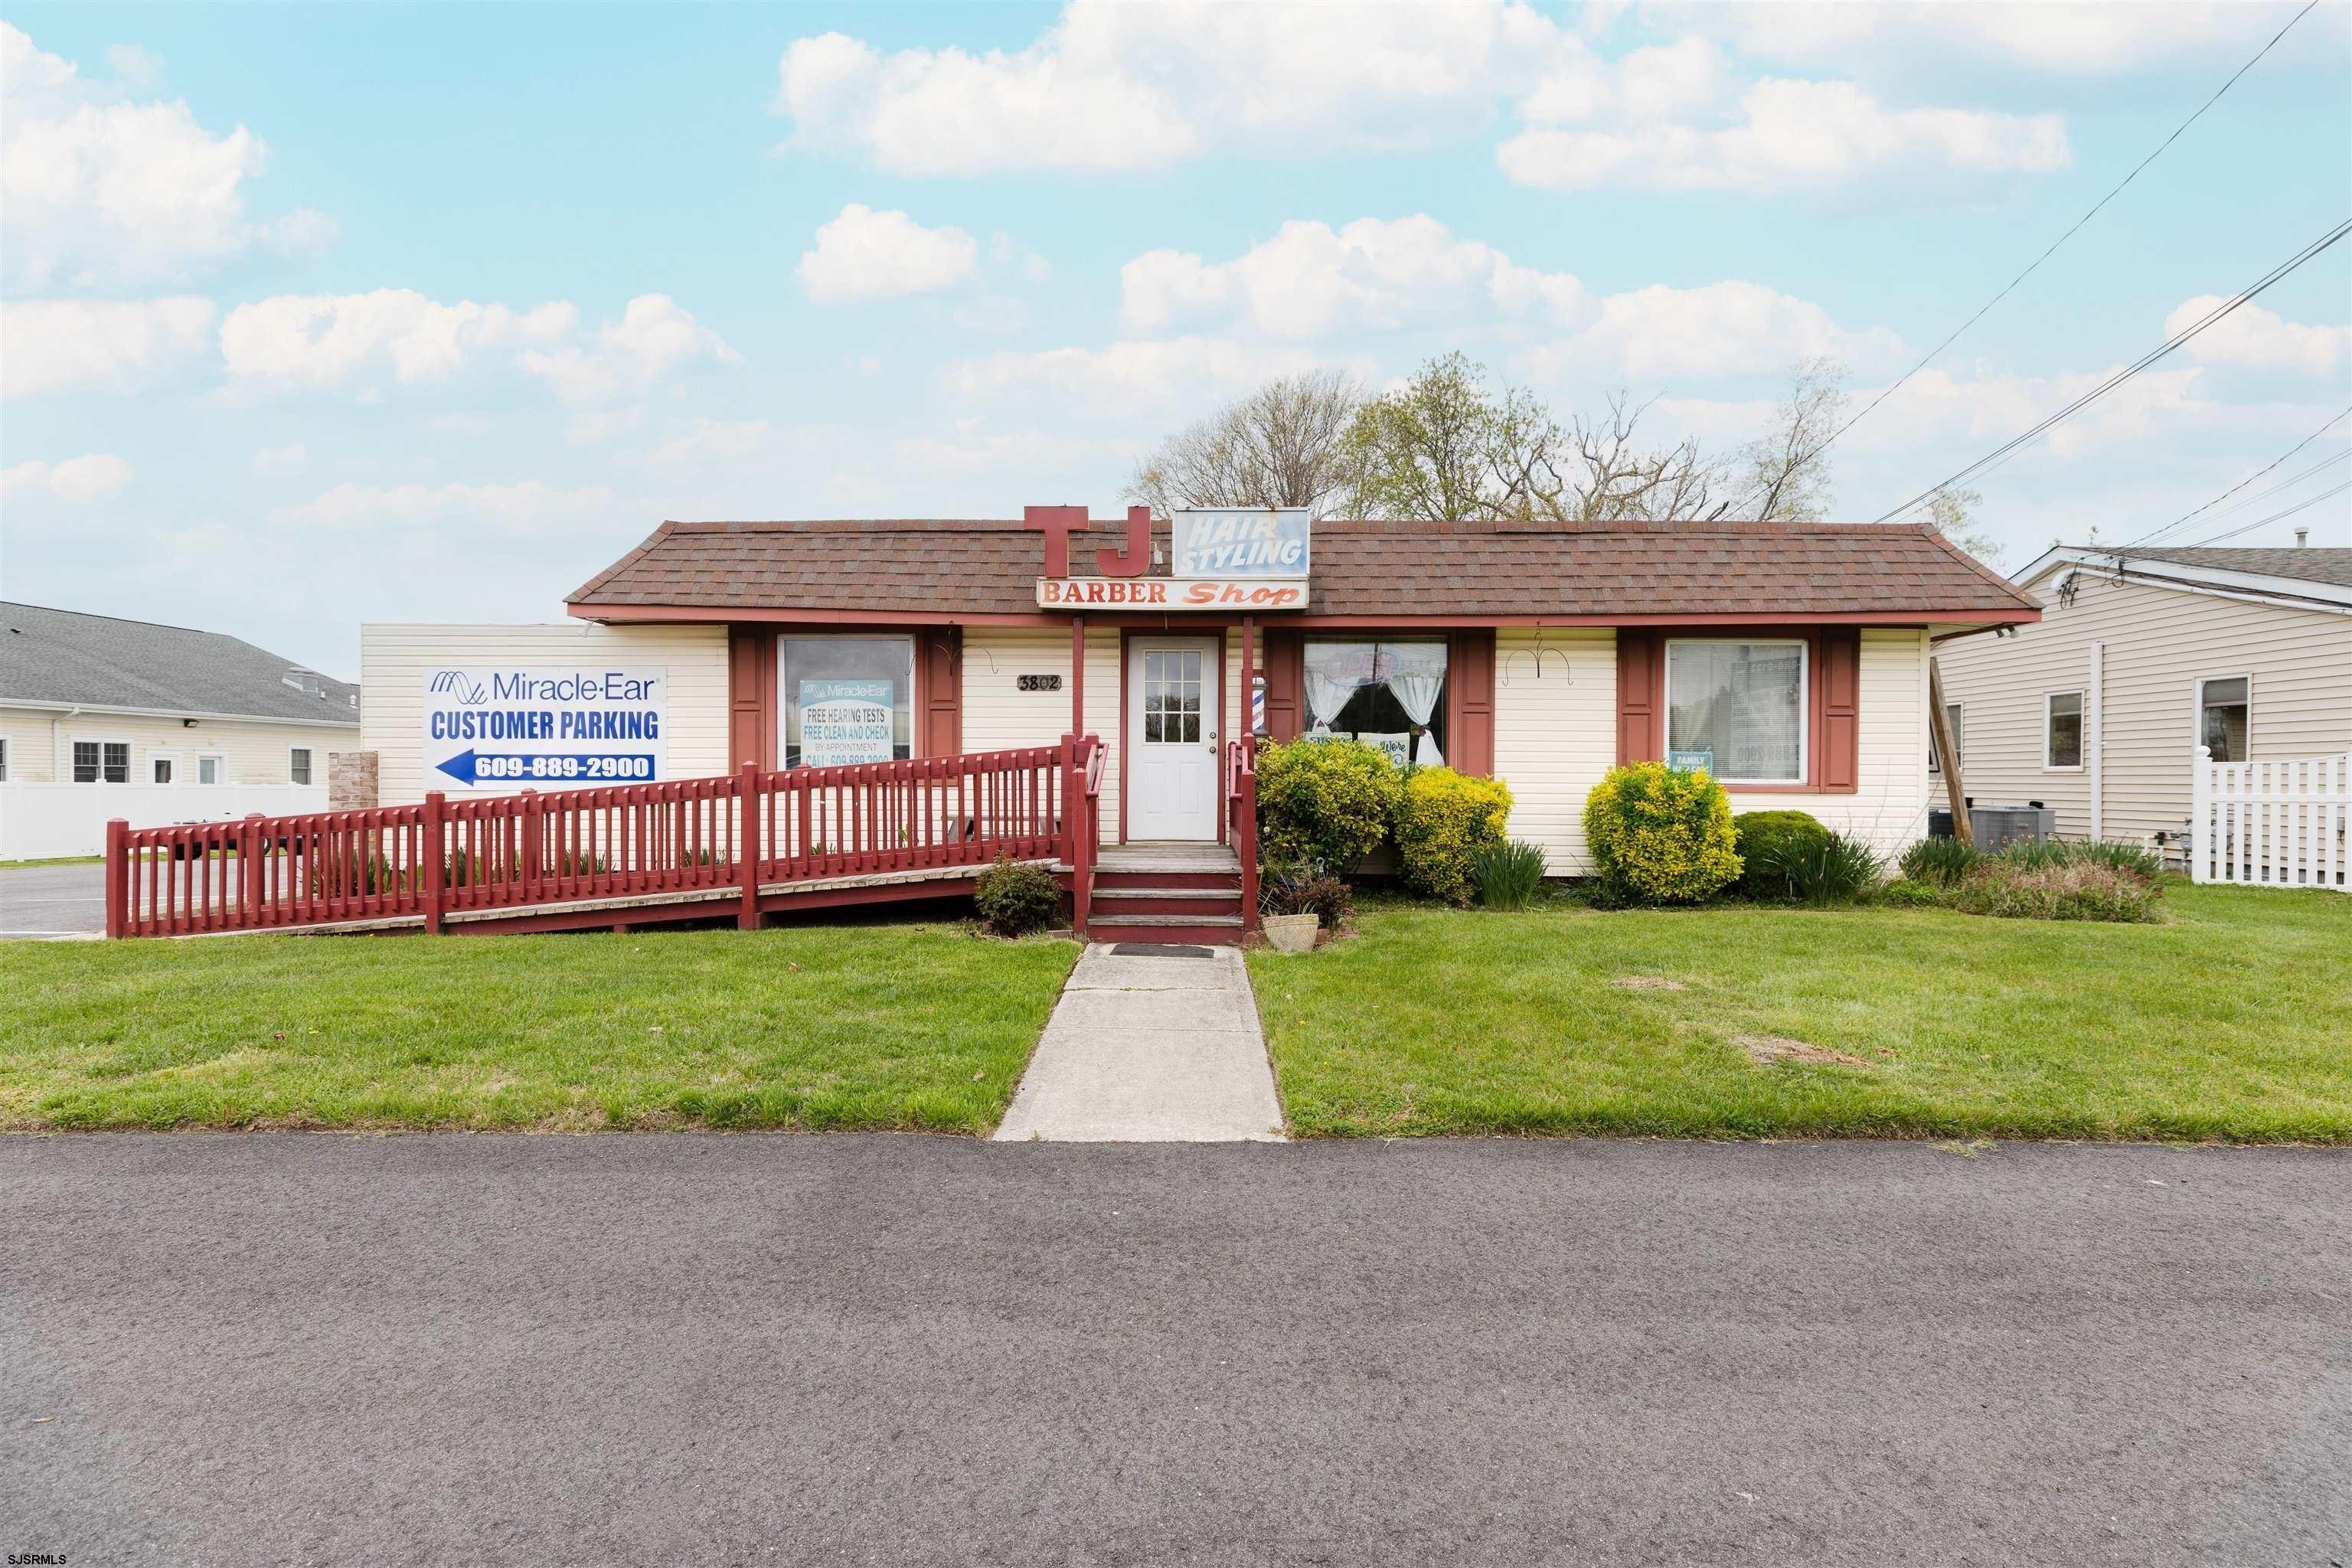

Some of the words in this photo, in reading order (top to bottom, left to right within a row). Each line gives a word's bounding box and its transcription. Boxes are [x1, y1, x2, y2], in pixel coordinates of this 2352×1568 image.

[1187, 516, 1278, 548] HAIR
[1178, 539, 1303, 572] STYLING
[1042, 582, 1168, 603] BARBER
[1182, 583, 1300, 606] Shop
[1018, 675, 1060, 691] 3802
[807, 708, 826, 723] FREE
[828, 708, 861, 723] HEARING
[862, 708, 885, 723] TESTS
[430, 710, 554, 740] CUSTOMER
[560, 710, 659, 740] PARKING
[804, 725, 822, 740] FREE
[824, 725, 847, 740] CLEAN
[848, 725, 864, 740] AND
[865, 725, 890, 740] CHECK
[815, 743, 825, 752] BY
[826, 743, 877, 752] APPOINTMENT
[475, 757, 649, 778] 609-889-2900
[1677, 756, 1704, 765] FAMILY
